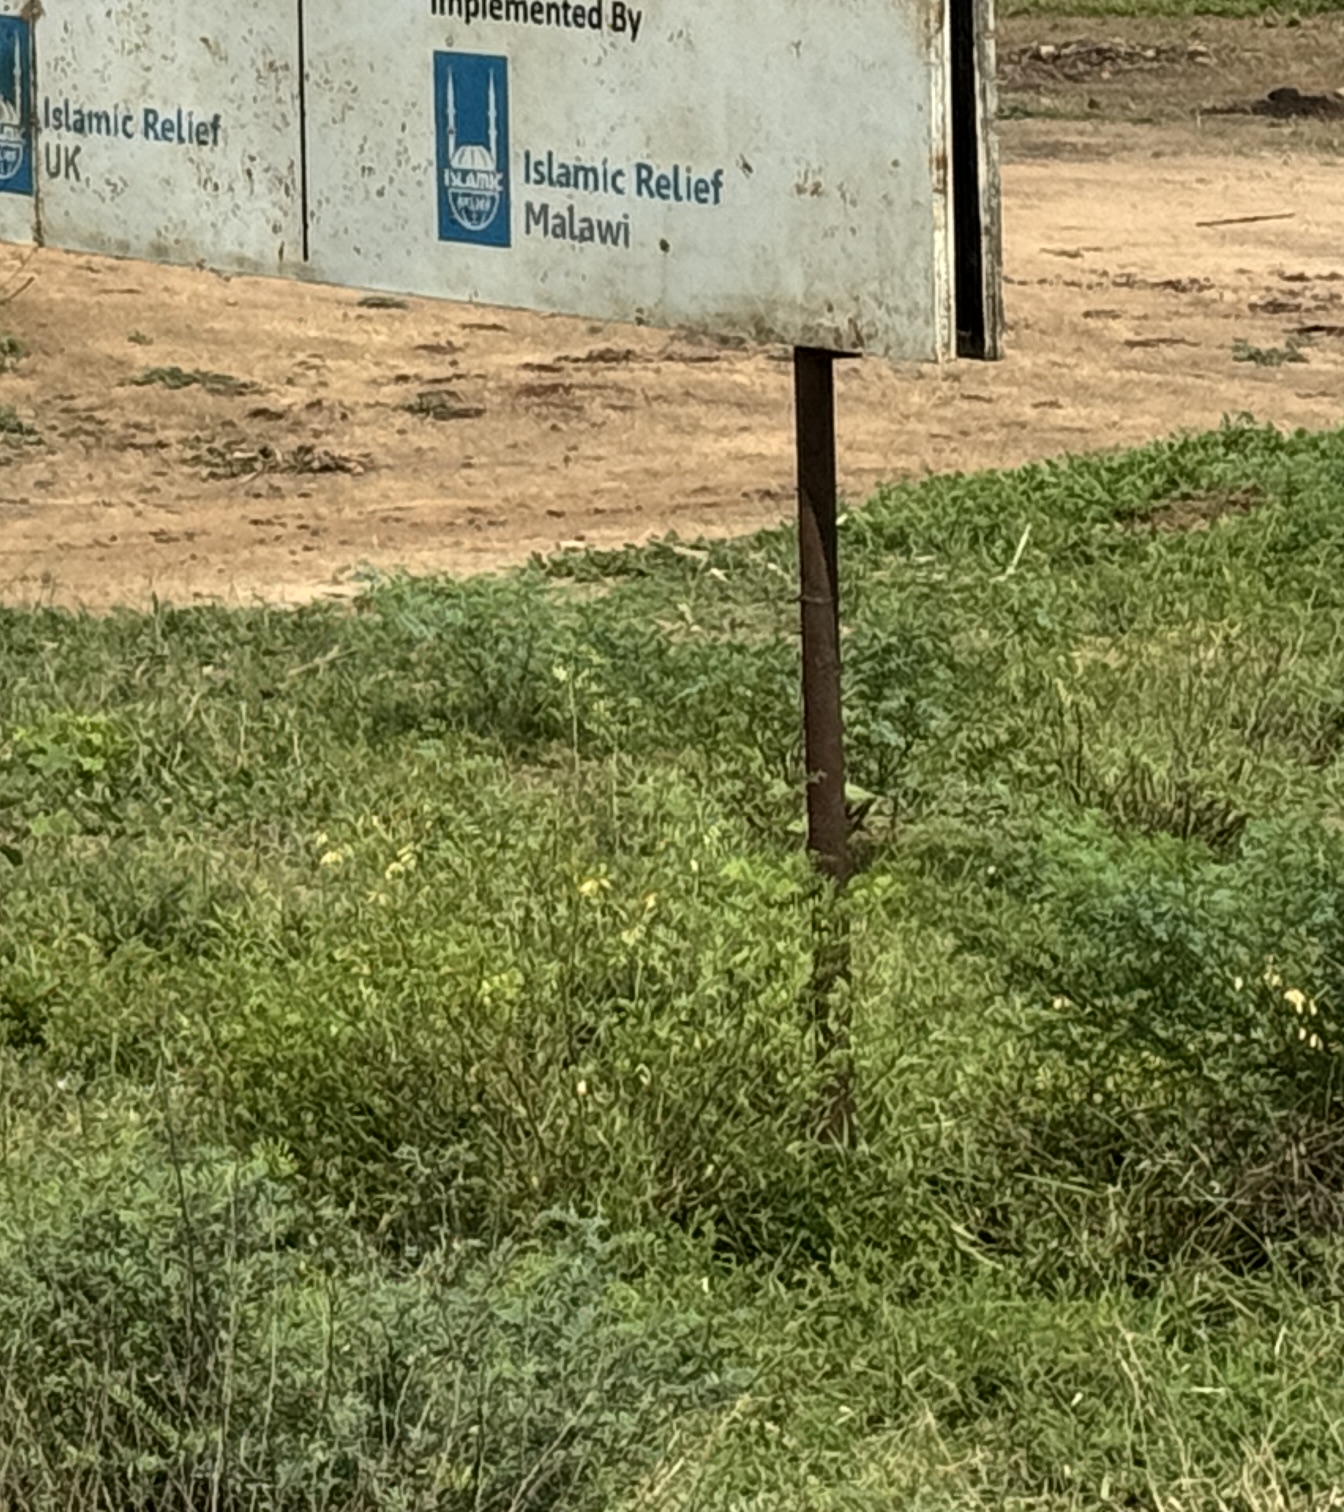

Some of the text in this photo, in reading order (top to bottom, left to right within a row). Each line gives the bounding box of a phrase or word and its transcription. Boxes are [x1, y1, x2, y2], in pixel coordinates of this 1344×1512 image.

[611, 0, 643, 43] By
[43, 95, 135, 140] Islamic
[143, 107, 223, 148] Relief
[44, 140, 83, 183] UK
[523, 148, 725, 206] Islamic Relief
[523, 199, 631, 250] Malawi
